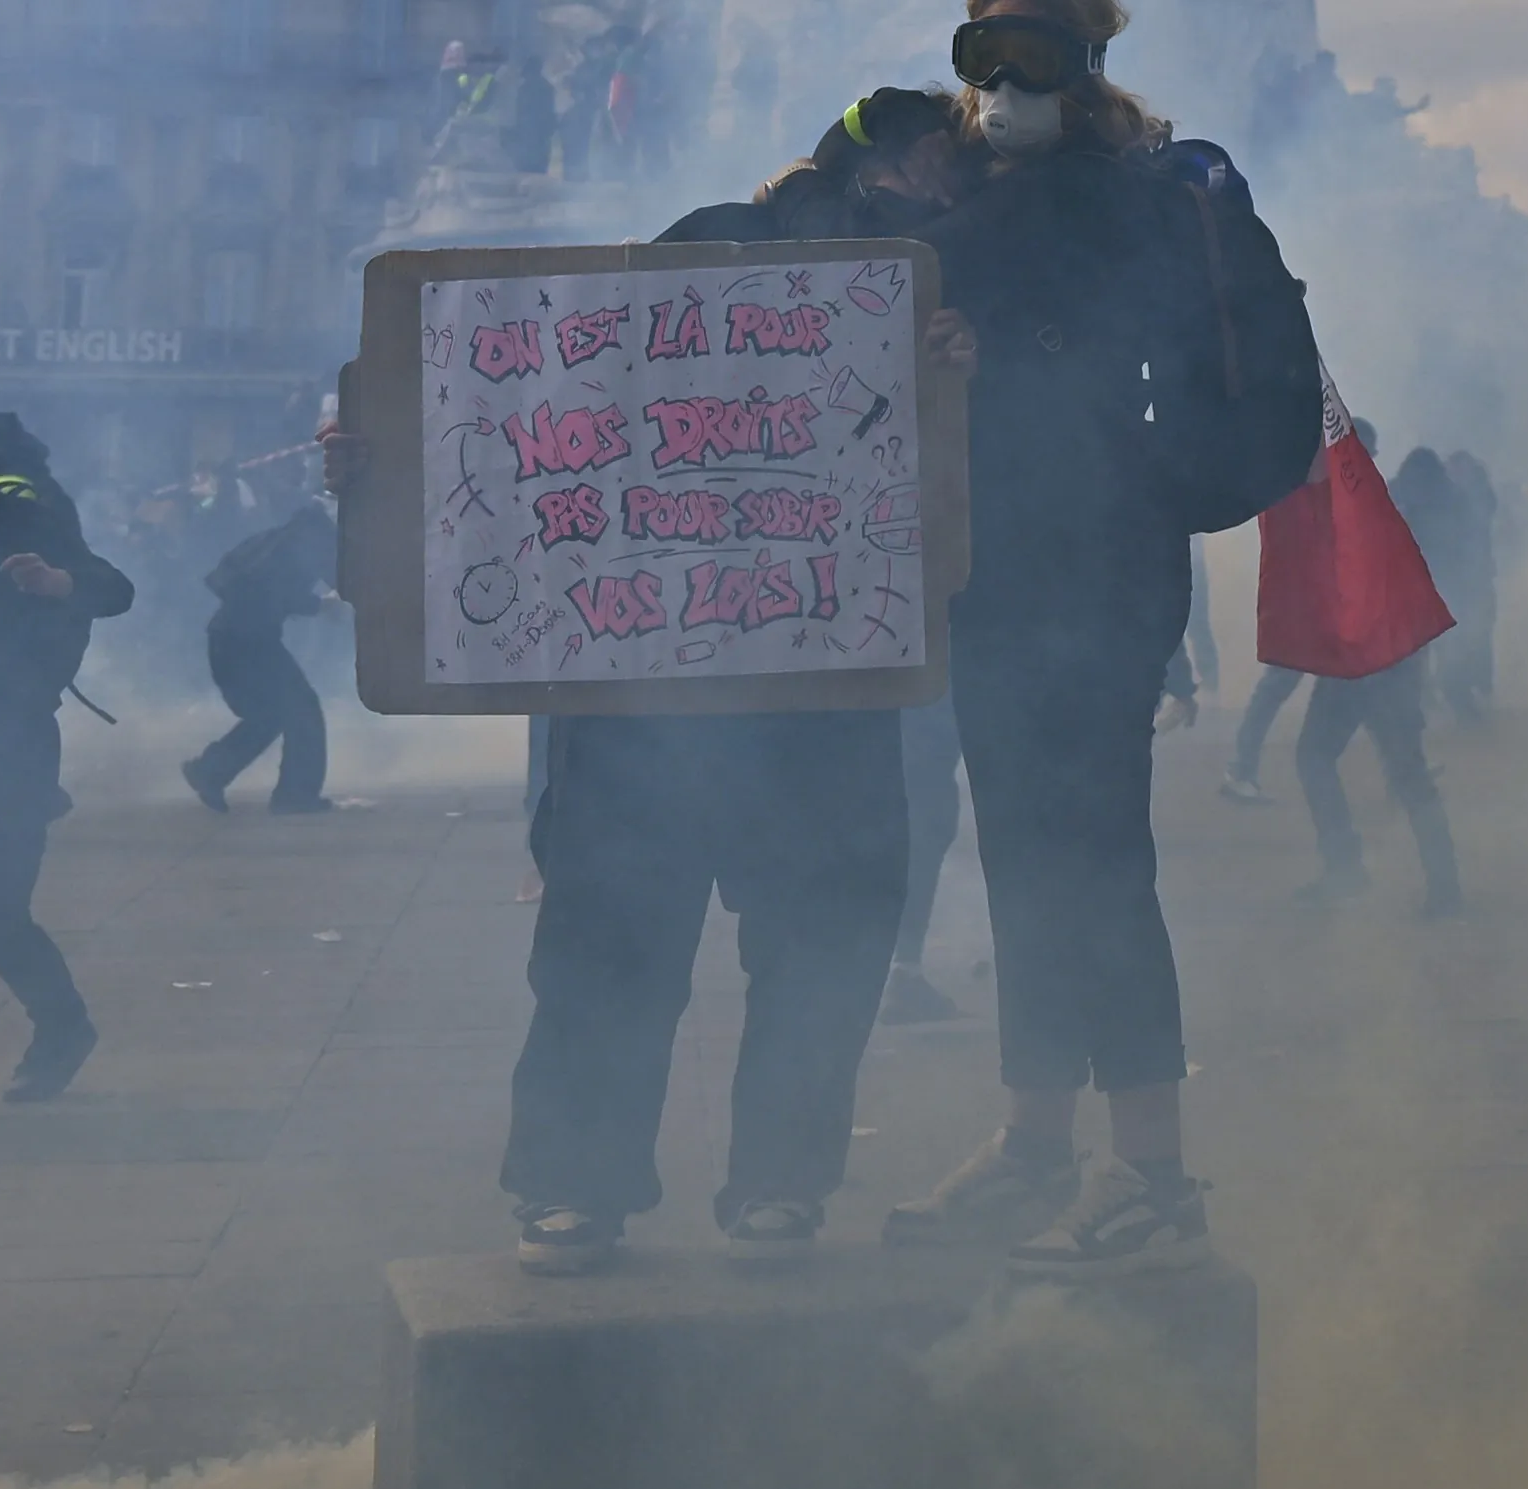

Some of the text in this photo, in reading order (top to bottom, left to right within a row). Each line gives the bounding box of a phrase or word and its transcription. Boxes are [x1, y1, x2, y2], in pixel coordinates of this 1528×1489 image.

[36, 328, 182, 363] ENGLISH
[469, 285, 832, 384] ON EST LÀ POUR
[501, 400, 631, 483] NOS
[533, 482, 610, 552] PAS
[621, 485, 731, 545] POUR
[564, 569, 667, 641] VOS
